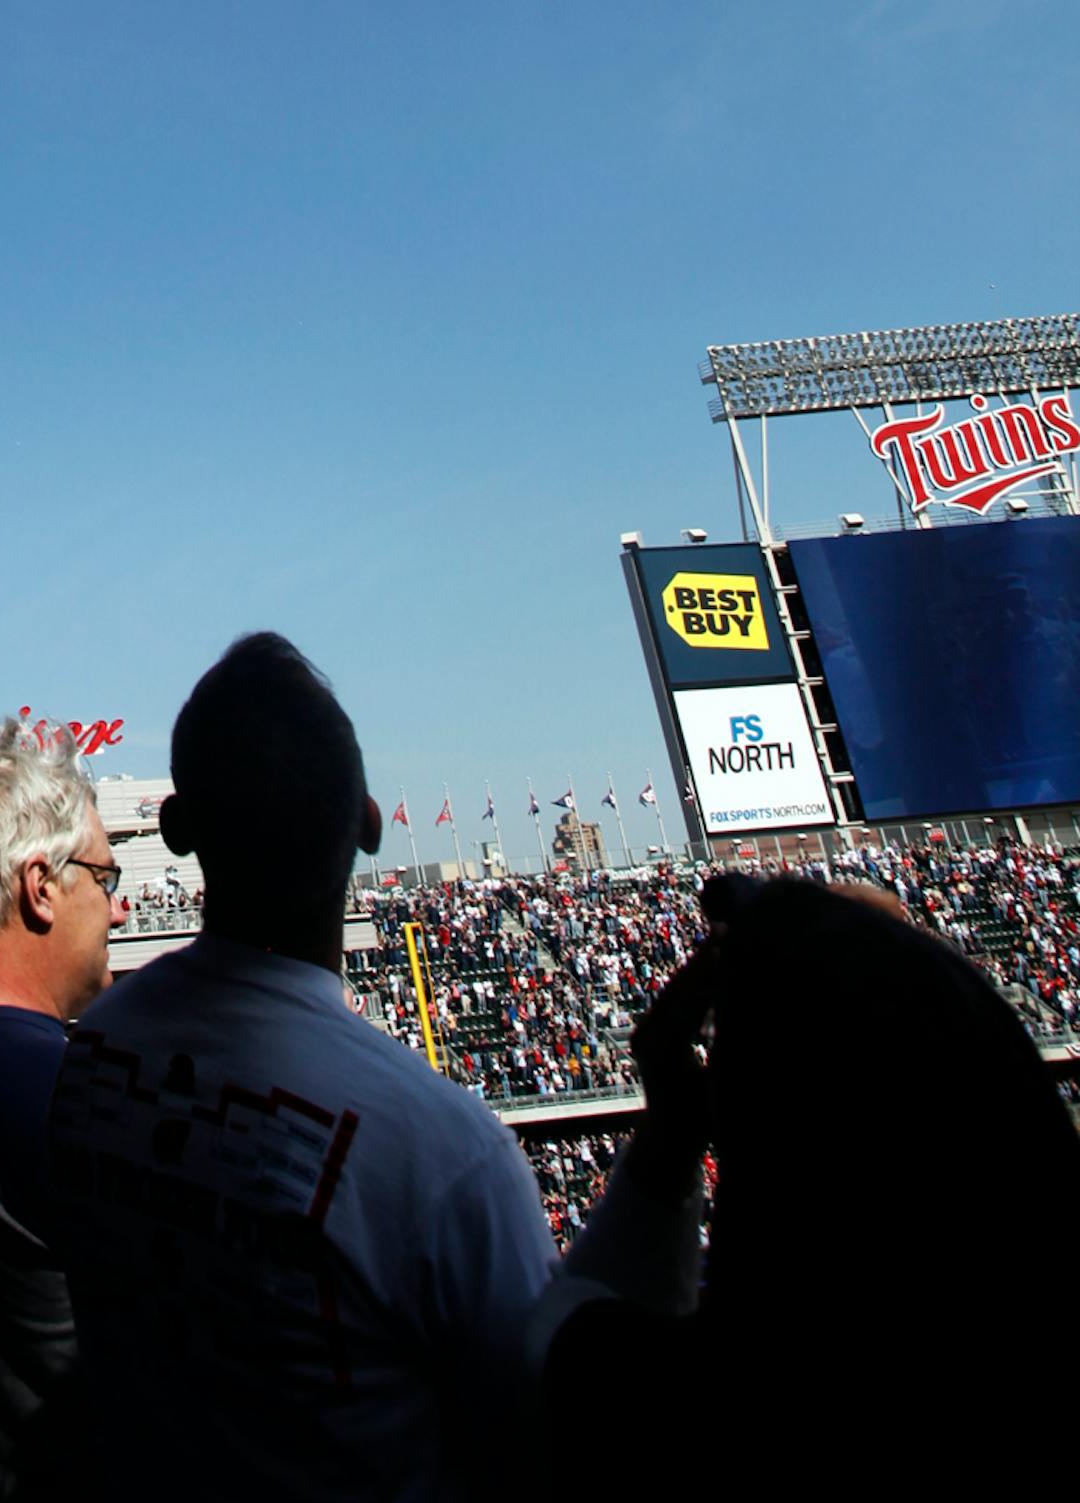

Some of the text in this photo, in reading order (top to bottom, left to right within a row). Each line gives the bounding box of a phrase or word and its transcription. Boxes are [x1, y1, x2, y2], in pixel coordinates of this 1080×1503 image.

[872, 395, 1080, 512] Twins
[674, 587, 756, 613] BEST
[682, 611, 754, 637] BUY
[729, 713, 764, 743] FS
[708, 742, 795, 775] NORTH
